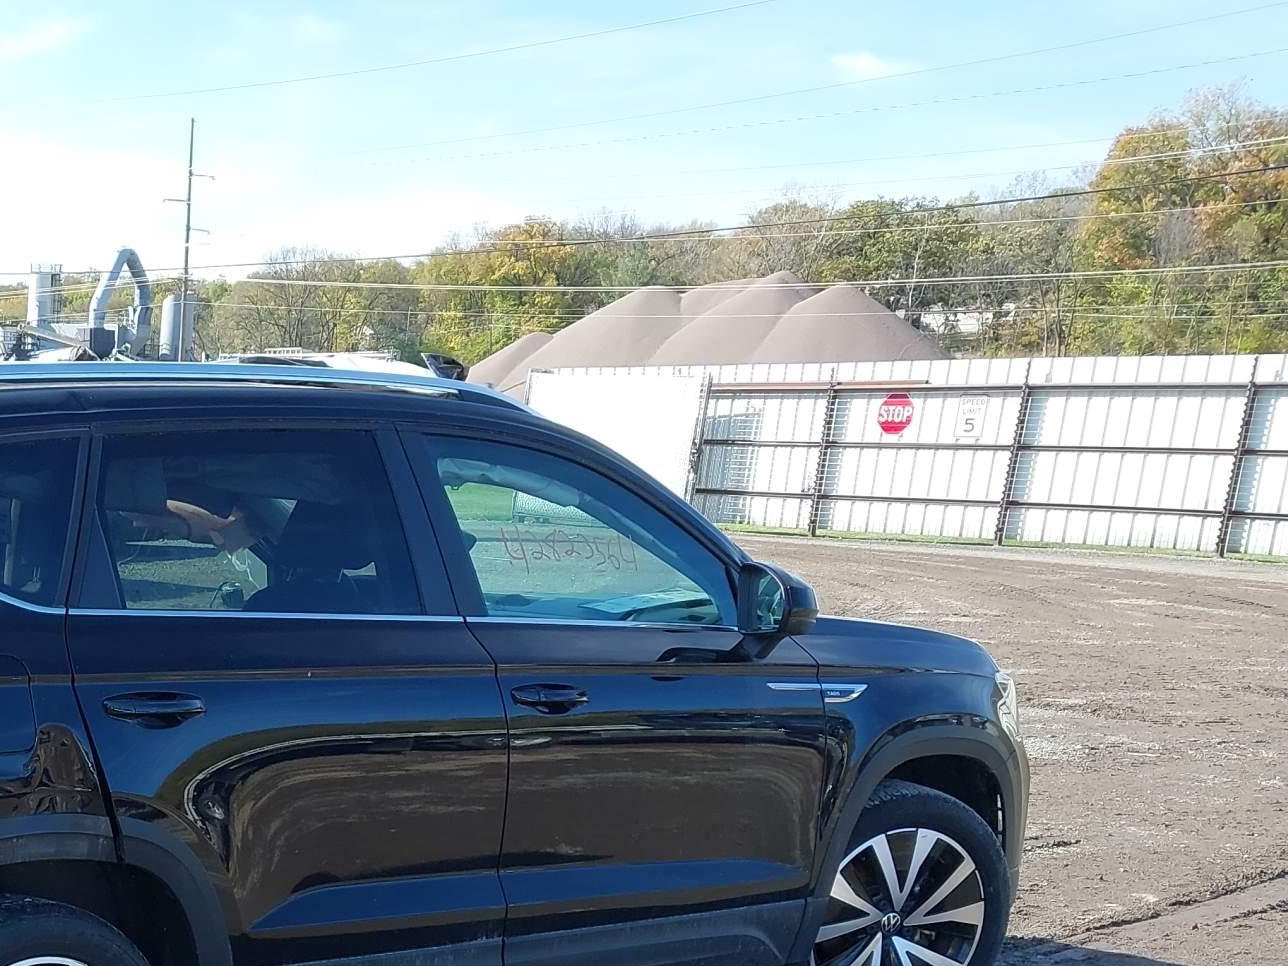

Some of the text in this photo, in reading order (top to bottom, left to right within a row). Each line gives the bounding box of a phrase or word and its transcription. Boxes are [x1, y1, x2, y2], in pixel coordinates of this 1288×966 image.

[961, 398, 986, 406] SPEED
[879, 405, 913, 423] STOP
[962, 407, 982, 416] LIMIT
[962, 417, 976, 433] 5
